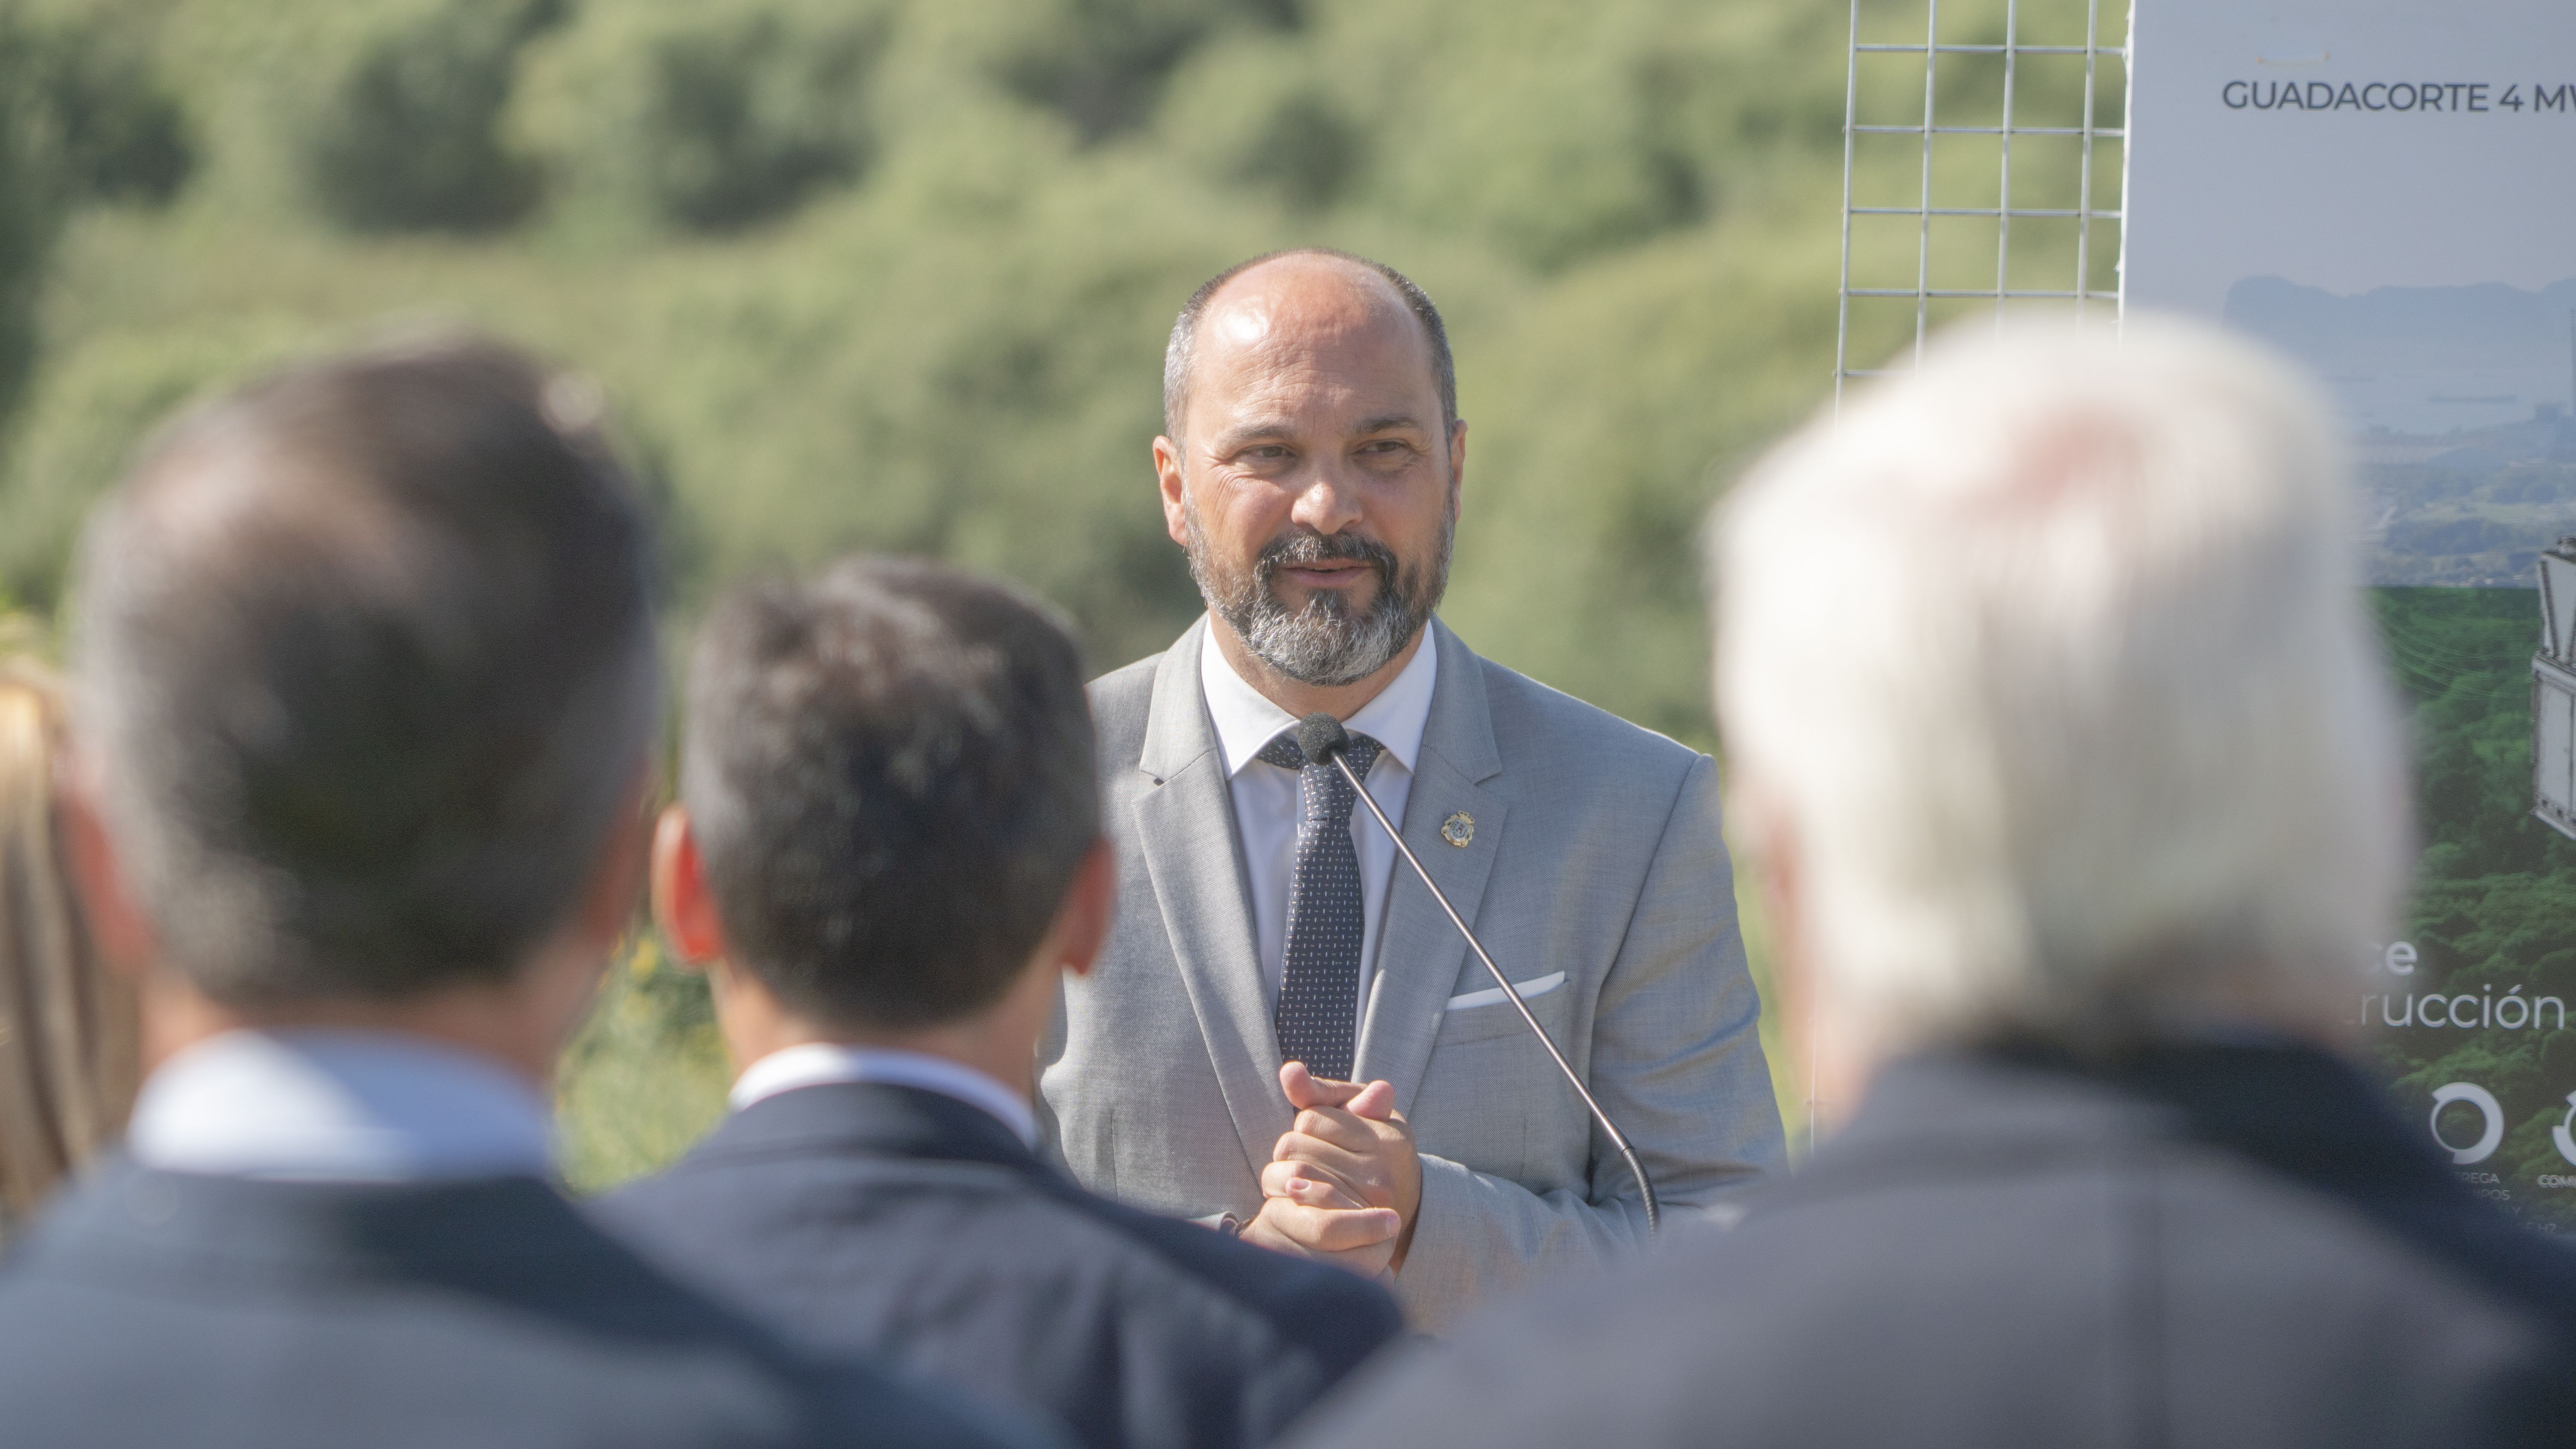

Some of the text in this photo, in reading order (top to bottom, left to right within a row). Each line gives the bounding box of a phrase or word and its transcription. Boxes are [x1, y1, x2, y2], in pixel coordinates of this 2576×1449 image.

[2222, 81, 2489, 112] GUADACORTE
[2499, 85, 2524, 112] 4
[2348, 983, 2565, 1030] rucción
[2458, 1173, 2500, 1184] REGA
[2476, 1189, 2511, 1200] POS
